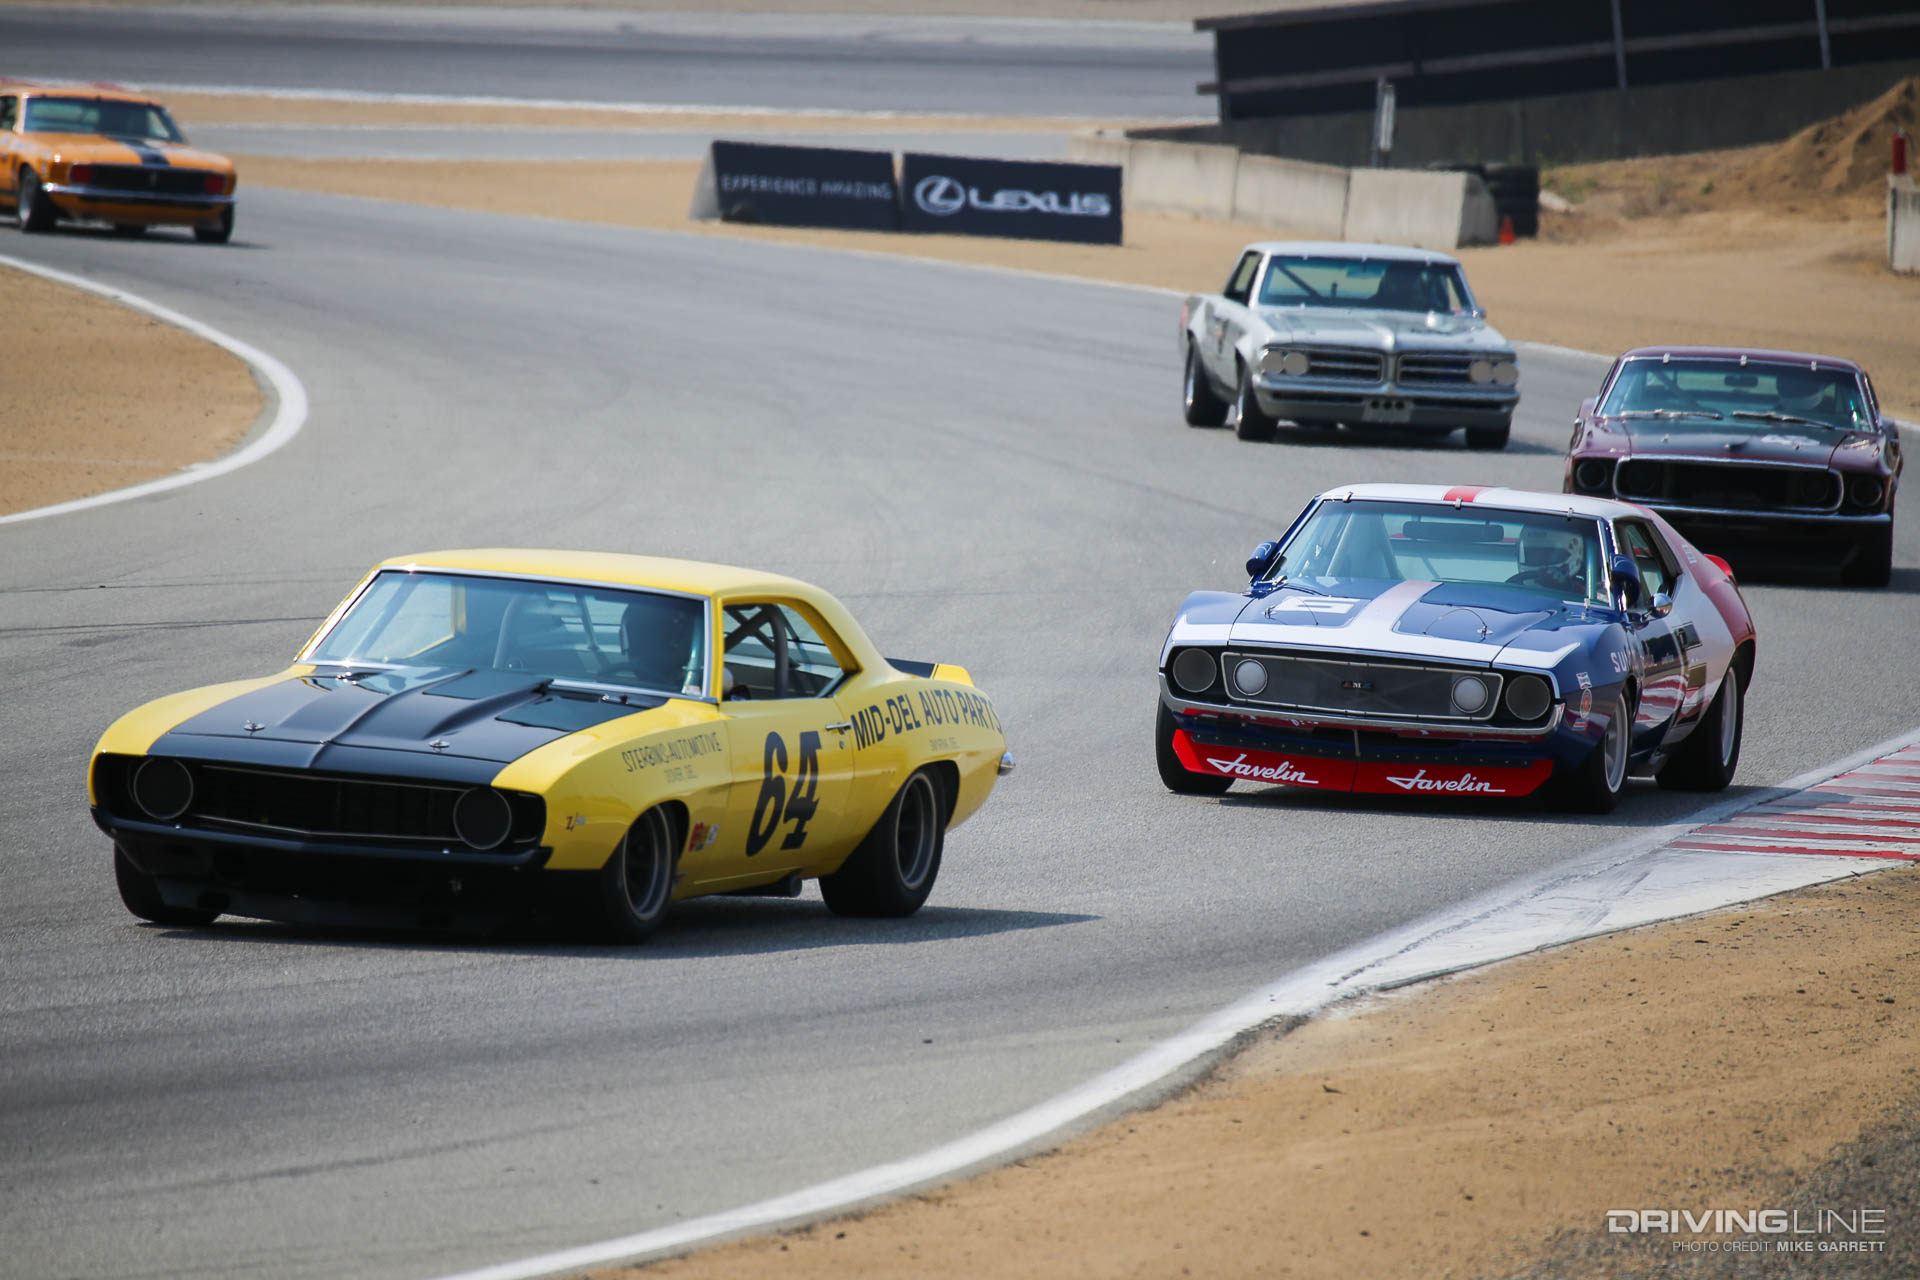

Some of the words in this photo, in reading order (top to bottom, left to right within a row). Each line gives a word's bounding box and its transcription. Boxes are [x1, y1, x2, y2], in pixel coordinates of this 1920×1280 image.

[721, 174, 817, 194] EXPERIENCE
[969, 188, 1111, 216] LEXUS
[851, 694, 921, 751] MID-DEL
[919, 689, 959, 726] AUTO
[1207, 754, 1319, 784] Javelin
[1387, 770, 1505, 793] Javelin
[746, 731, 822, 857] 64
